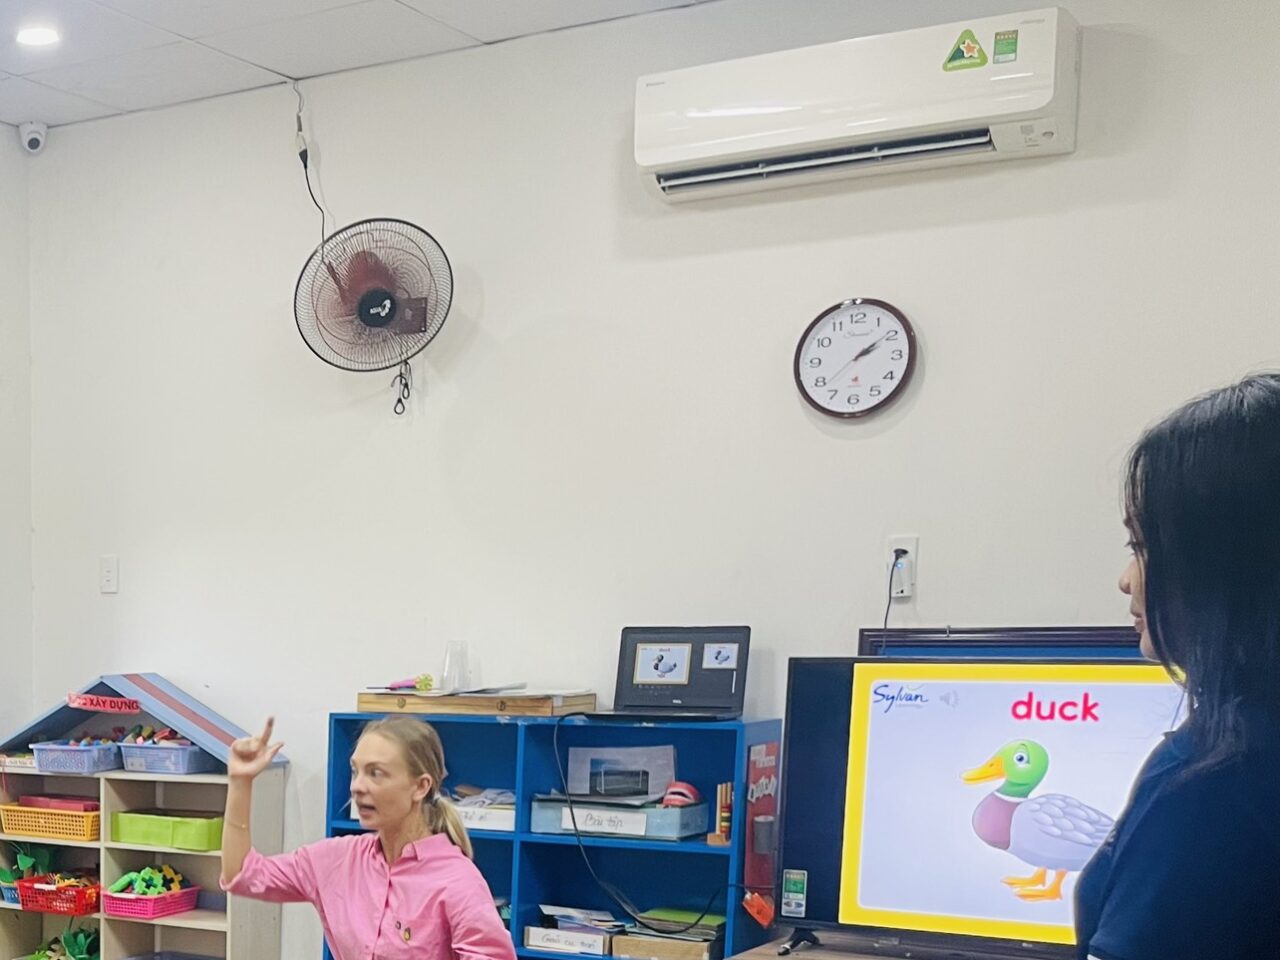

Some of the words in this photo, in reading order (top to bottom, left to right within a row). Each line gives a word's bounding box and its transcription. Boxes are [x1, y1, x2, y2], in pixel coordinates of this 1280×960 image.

[850, 313, 867, 325] 12
[832, 321, 843, 332] 11
[885, 330, 899, 341] 2
[817, 337, 832, 348] 10
[891, 350, 903, 361] 3
[809, 357, 822, 368] 9
[814, 376, 827, 388] 8
[882, 371, 895, 382] 4
[827, 389, 839, 401] 7
[869, 386, 881, 397] 5
[847, 394, 860, 405] 6
[873, 684, 928, 713] Sylvan
[1011, 691, 1099, 722] duck
